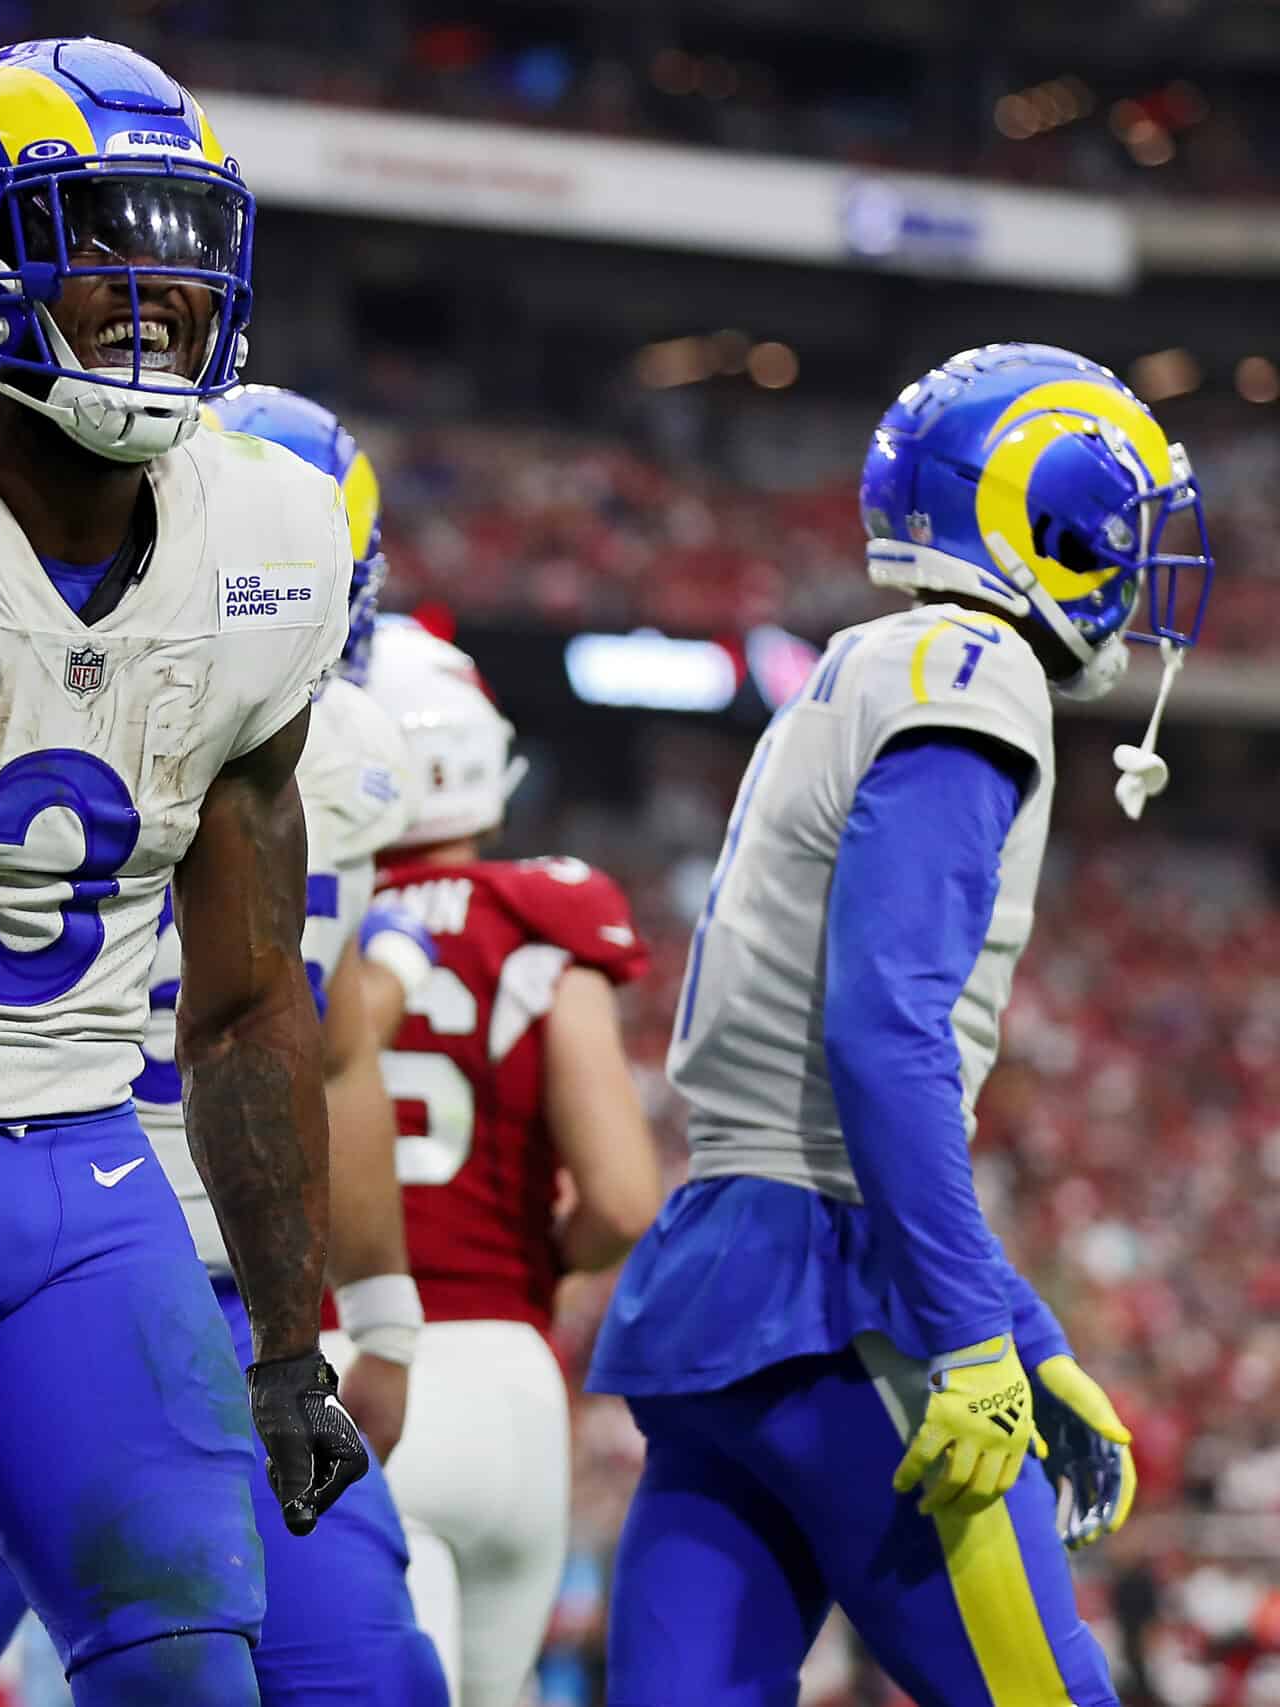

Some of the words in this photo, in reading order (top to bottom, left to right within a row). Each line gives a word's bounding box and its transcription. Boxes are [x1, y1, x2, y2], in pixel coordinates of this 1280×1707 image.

[128, 132, 191, 151] RAMS
[225, 576, 261, 590] LOS
[226, 588, 312, 604] ANGELES
[226, 603, 278, 617] RAMS
[951, 642, 983, 690] 1
[71, 666, 99, 688] NFL
